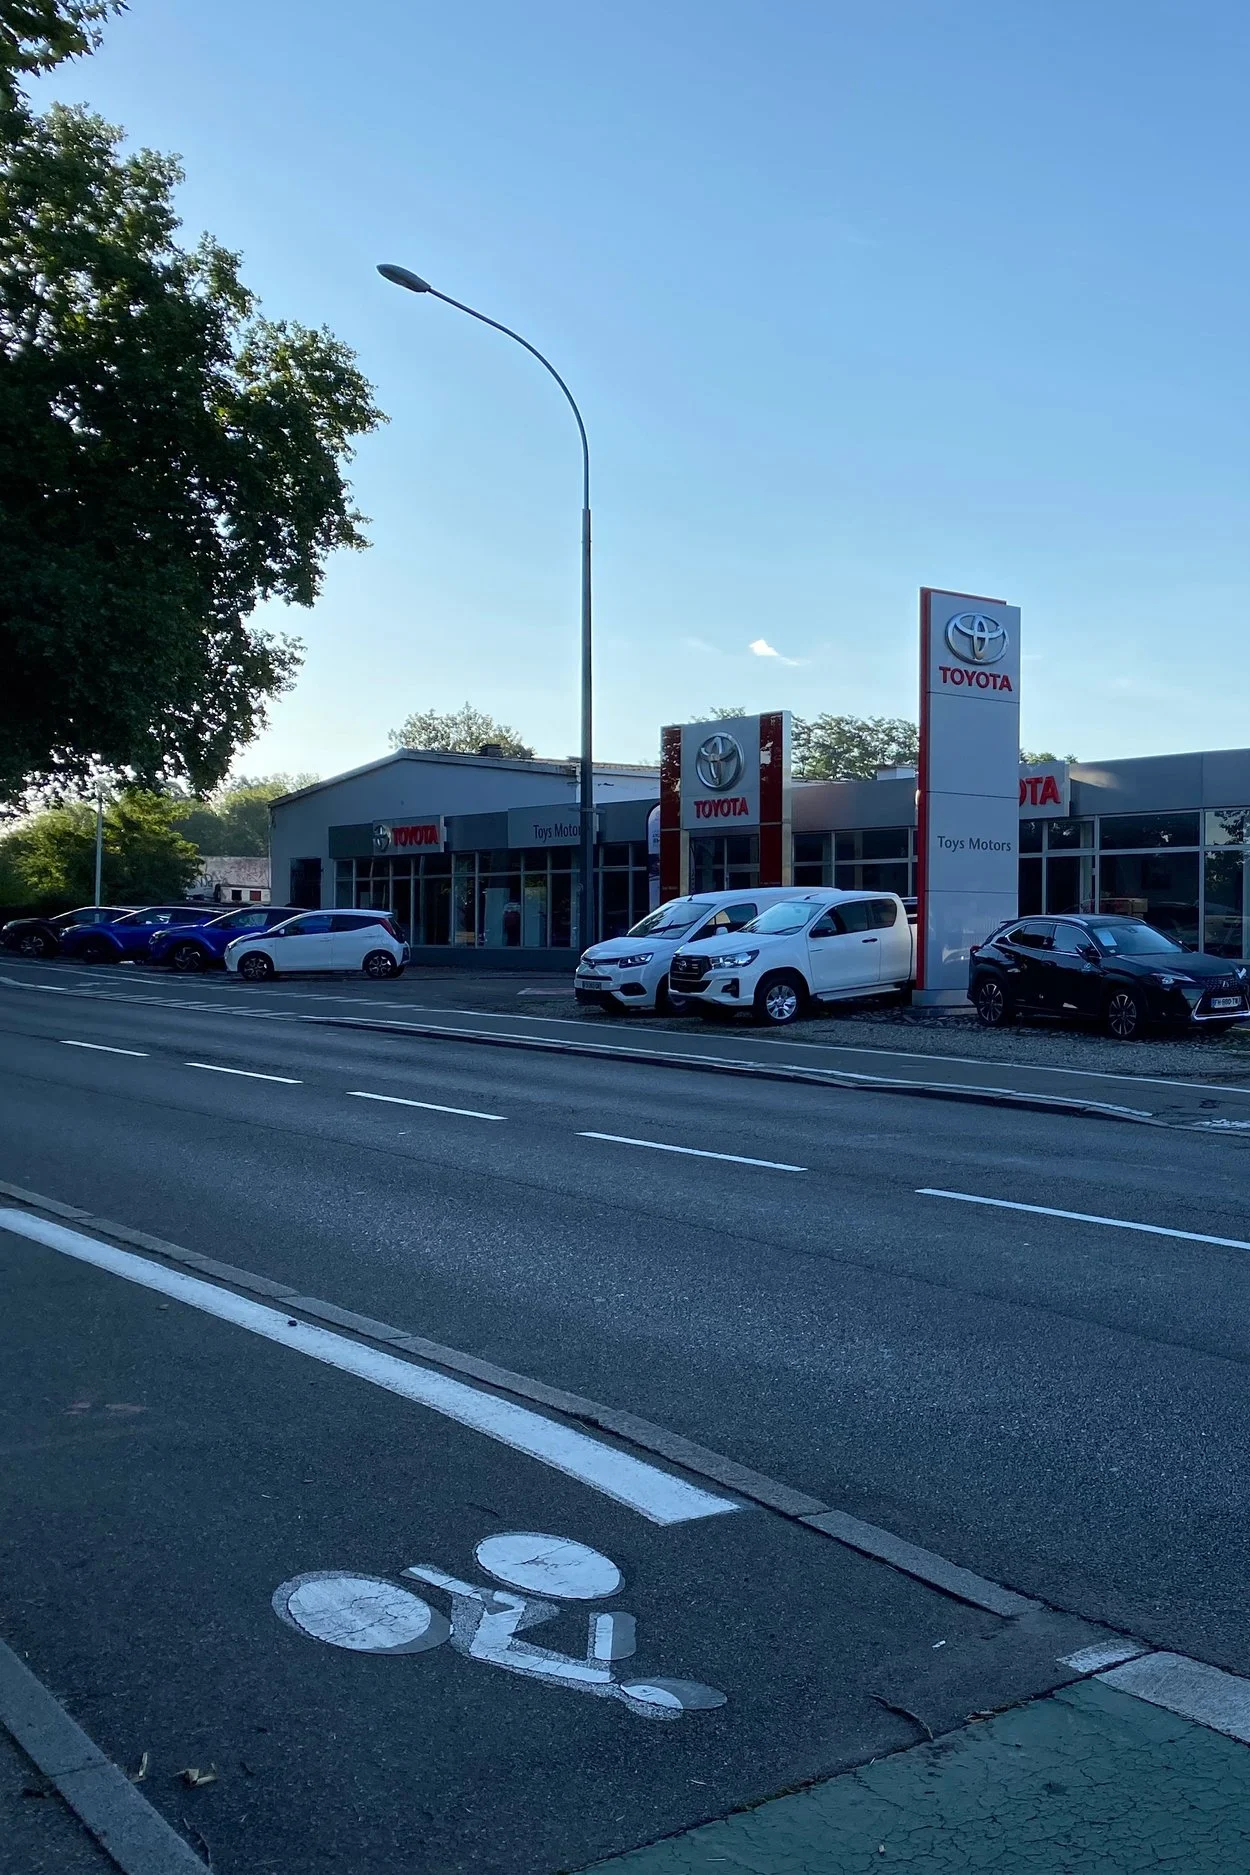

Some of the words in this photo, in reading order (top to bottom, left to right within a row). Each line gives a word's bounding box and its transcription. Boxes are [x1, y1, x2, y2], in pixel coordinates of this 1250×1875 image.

[938, 666, 1012, 691] TOYOTA
[694, 797, 748, 818] TOYOTA
[392, 825, 438, 846] TOYOTA
[533, 825, 551, 842] Toys
[937, 836, 965, 852] Toys
[969, 838, 1011, 851] Motors
